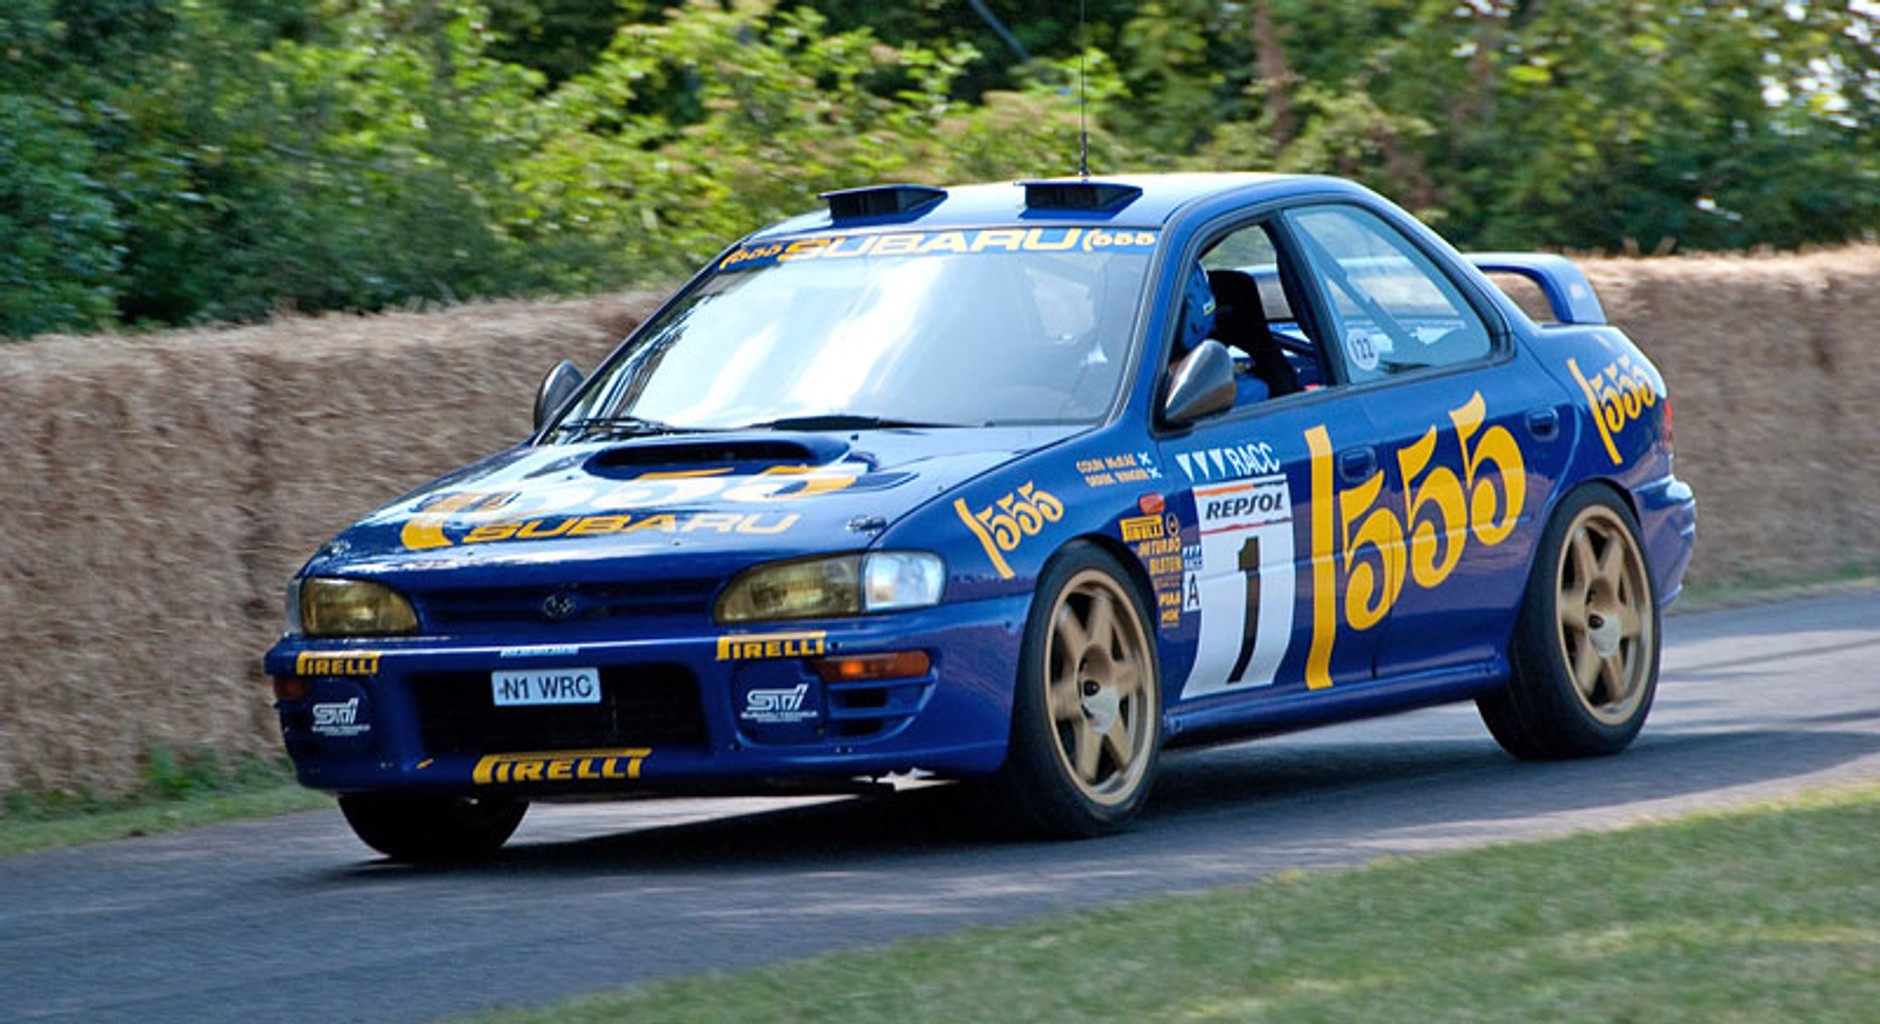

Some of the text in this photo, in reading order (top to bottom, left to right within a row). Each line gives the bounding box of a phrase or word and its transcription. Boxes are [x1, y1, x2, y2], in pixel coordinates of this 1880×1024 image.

[777, 228, 1082, 261] SUBARU
[1350, 337, 1375, 361] 122
[1223, 442, 1280, 476] RACC
[1206, 493, 1284, 520] REPSOL
[463, 513, 799, 544] SUBARU
[1186, 573, 1200, 607] A
[1227, 535, 1262, 684] 1
[717, 631, 826, 660] PIRELLI
[296, 651, 381, 675] PIRELLI
[504, 674, 593, 700] N1 WRC
[472, 747, 652, 784] PIRELLI
